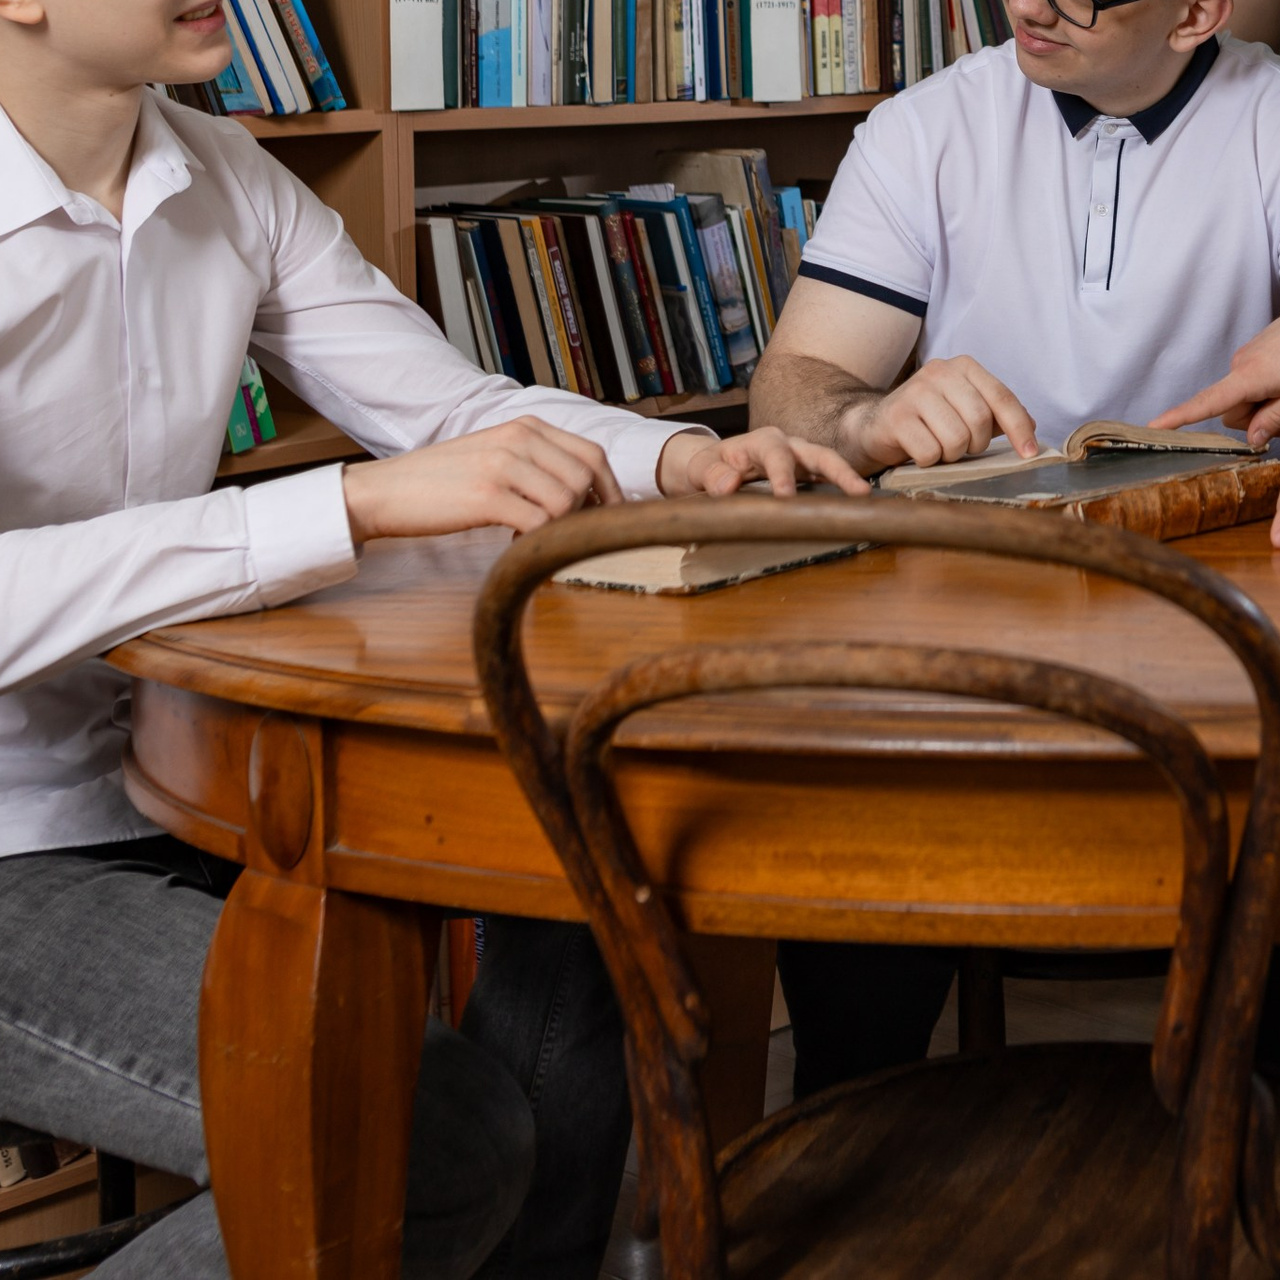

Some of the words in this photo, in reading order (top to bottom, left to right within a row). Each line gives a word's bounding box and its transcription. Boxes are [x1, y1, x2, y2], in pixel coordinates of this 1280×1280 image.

[756, 1, 796, 9] (1721-1917)
[283, 8, 308, 51] земли
[846, 30, 856, 67] ЧЕСТЬ
